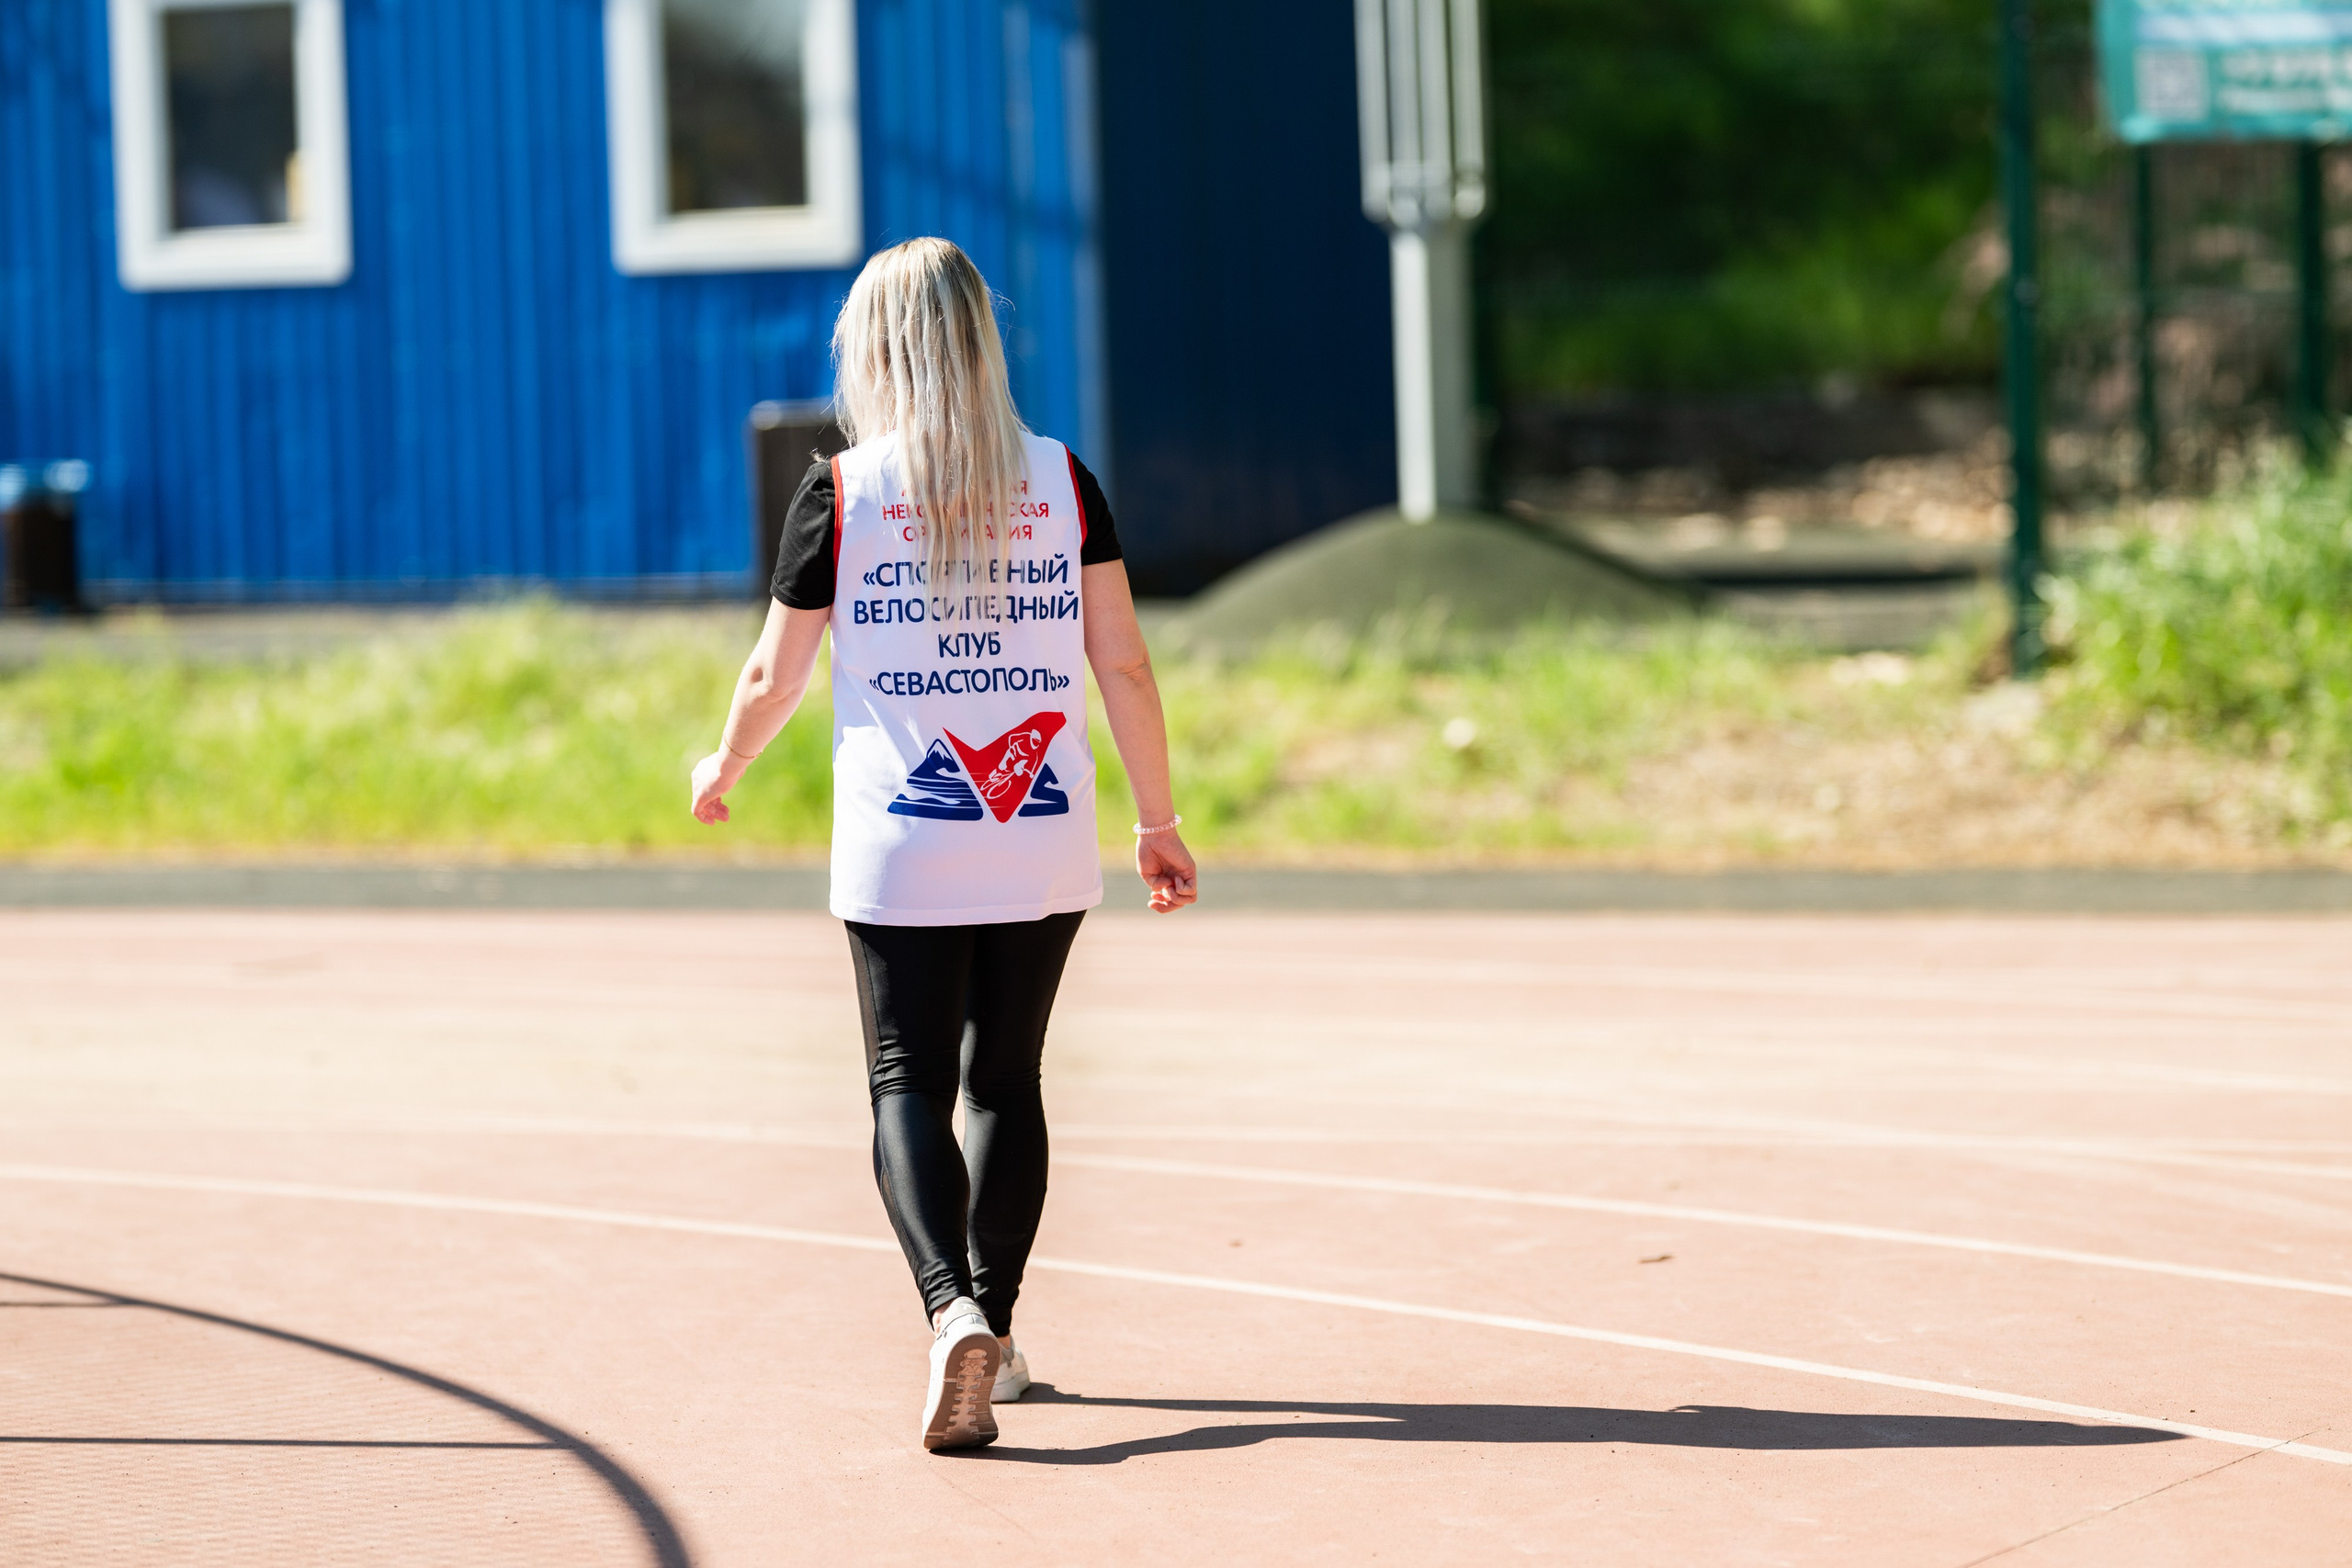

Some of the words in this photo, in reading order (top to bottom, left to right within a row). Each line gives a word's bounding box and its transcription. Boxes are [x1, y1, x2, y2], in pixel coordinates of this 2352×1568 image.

[854, 590, 1079, 625] ВЕЛОСИПЕДНЫЙ
[938, 631, 1001, 659] КЛУБ
[869, 667, 1070, 696] «СЕВАСТОПОЛЬ»
